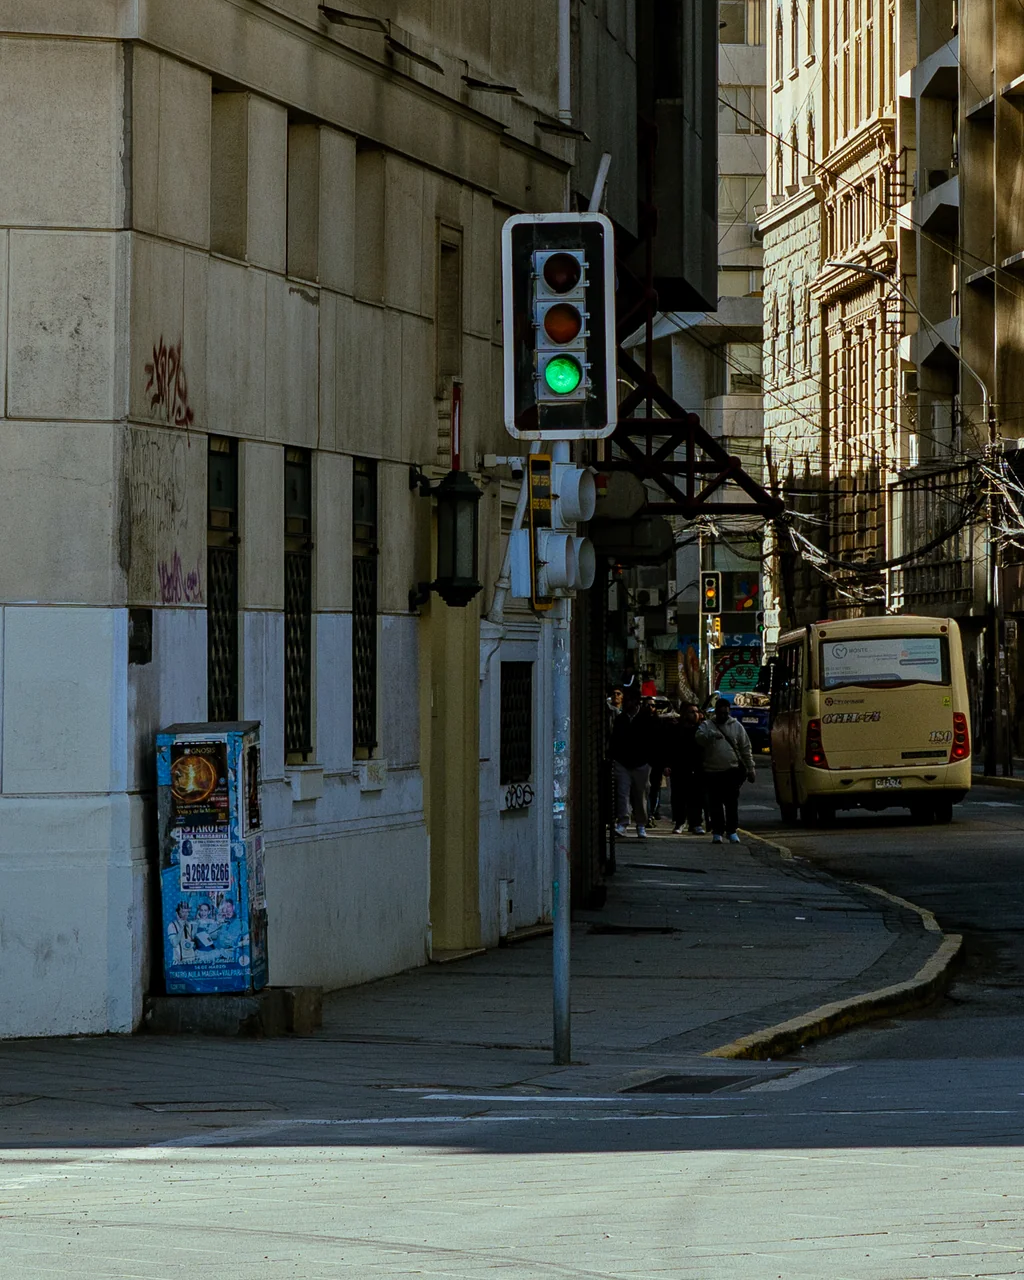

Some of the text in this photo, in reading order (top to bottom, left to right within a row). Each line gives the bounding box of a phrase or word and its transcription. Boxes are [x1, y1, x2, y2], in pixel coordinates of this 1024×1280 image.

[186, 863, 229, 882] 9 2682 6266
